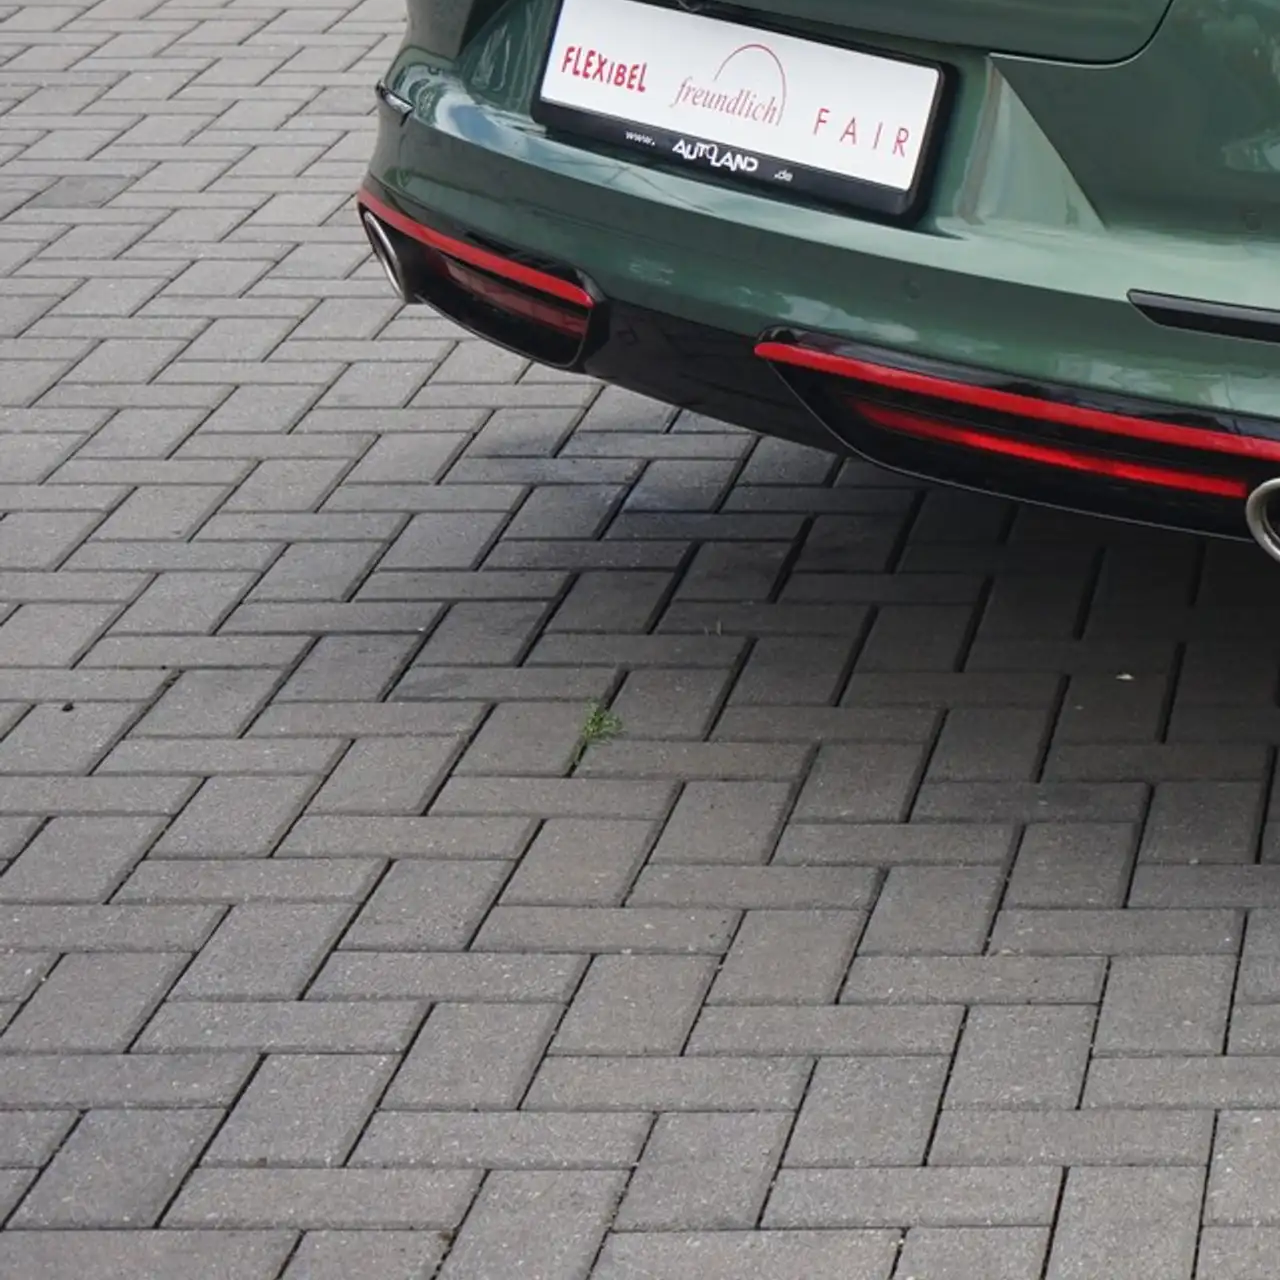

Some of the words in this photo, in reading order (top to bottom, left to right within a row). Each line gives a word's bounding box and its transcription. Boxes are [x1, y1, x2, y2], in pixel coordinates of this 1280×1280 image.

[562, 46, 648, 92] FLEXIBEL
[669, 76, 778, 124] freundlich
[813, 107, 910, 158] FAIR
[672, 138, 759, 171] AUTOLAND
